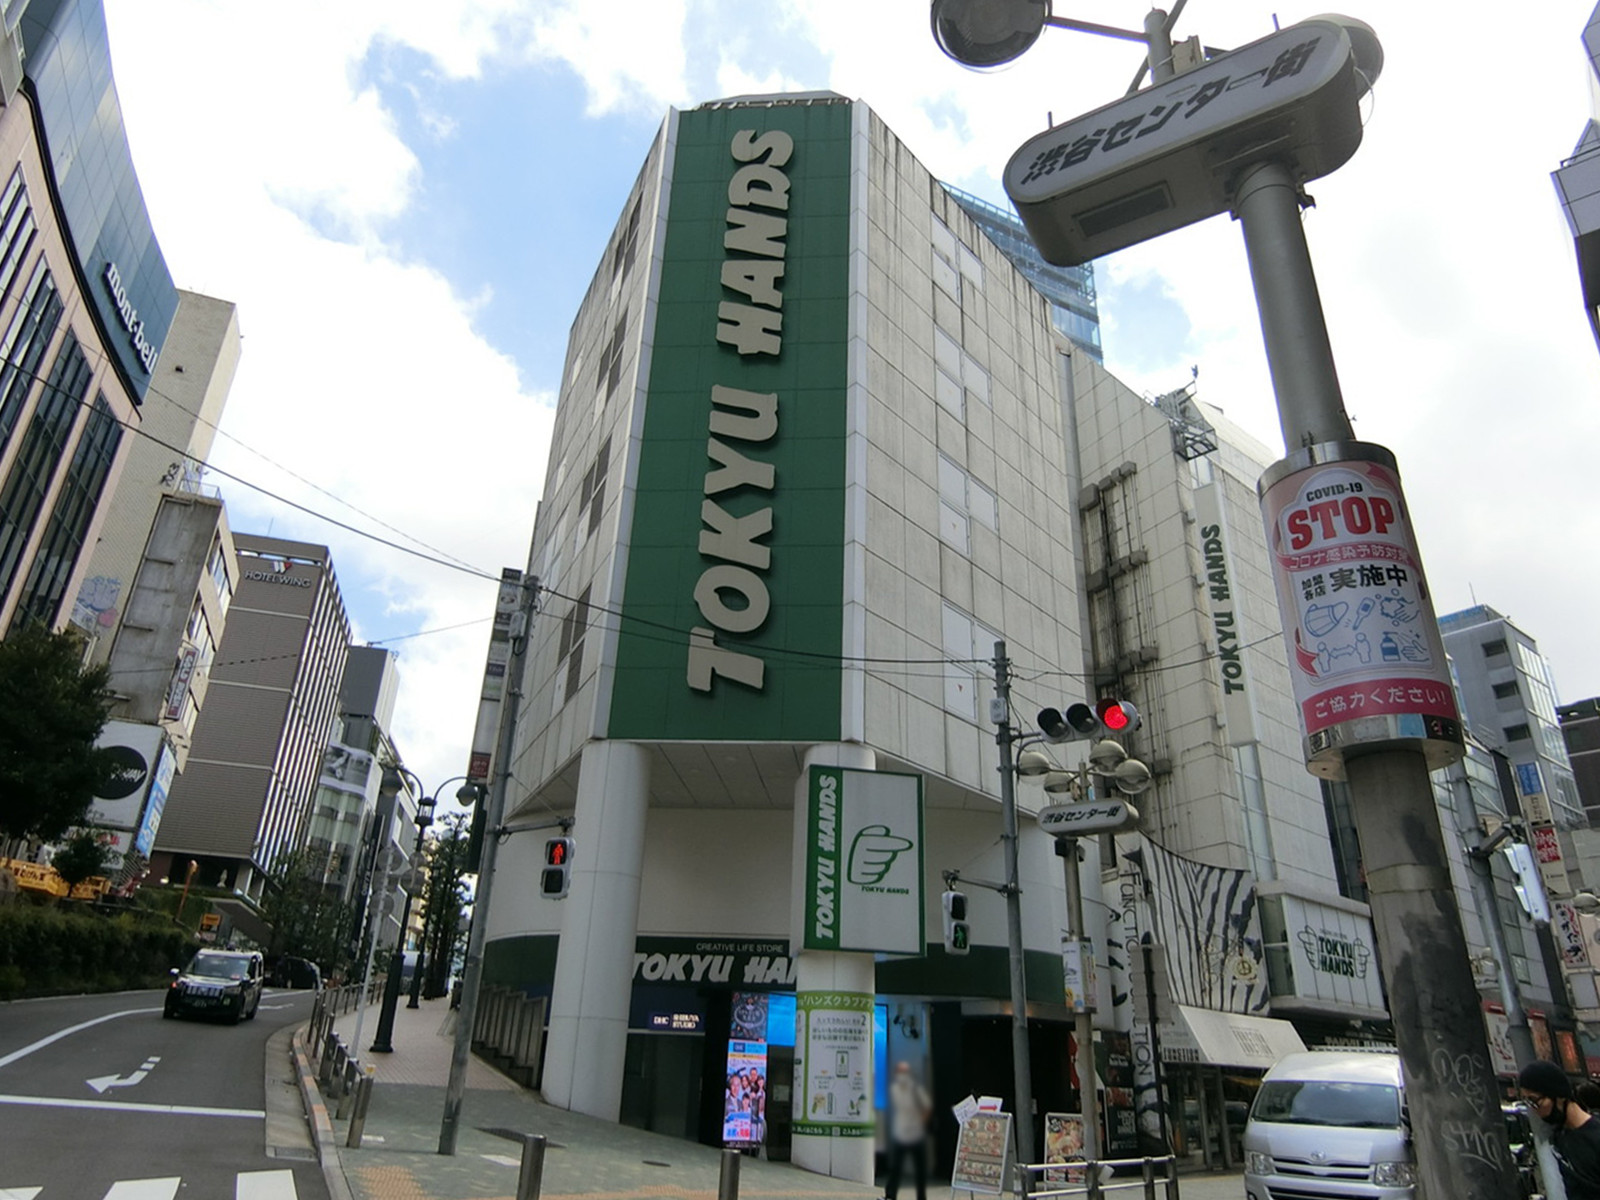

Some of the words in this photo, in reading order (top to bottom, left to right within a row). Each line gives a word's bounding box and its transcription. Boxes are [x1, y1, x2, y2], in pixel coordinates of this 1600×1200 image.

[1021, 37, 1321, 186] 渋谷センター街
[715, 129, 795, 356] HANDS
[1306, 482, 1363, 502] COVID-19
[1287, 496, 1394, 550] STOP
[686, 384, 780, 692] TOKYU
[1201, 524, 1230, 601] HANDS
[1289, 544, 1409, 569] コロナ感染予防対策
[244, 571, 277, 583] HOTEL
[279, 575, 311, 588] WING
[1329, 564, 1408, 592] 実施中
[1214, 611, 1244, 695] TOKYU
[817, 774, 837, 852] HANDS
[1042, 805, 1121, 824] 渋谷センター街
[816, 857, 835, 939] TOKYU
[861, 885, 885, 893] TOKYU
[886, 887, 909, 895] HANDS
[696, 942, 735, 951] CREATIVE
[737, 943, 753, 952] LIFE
[756, 944, 784, 954] STORE
[1318, 936, 1352, 959] TOKYU
[632, 953, 735, 983] TOKYU
[1321, 955, 1354, 978] HANDS
